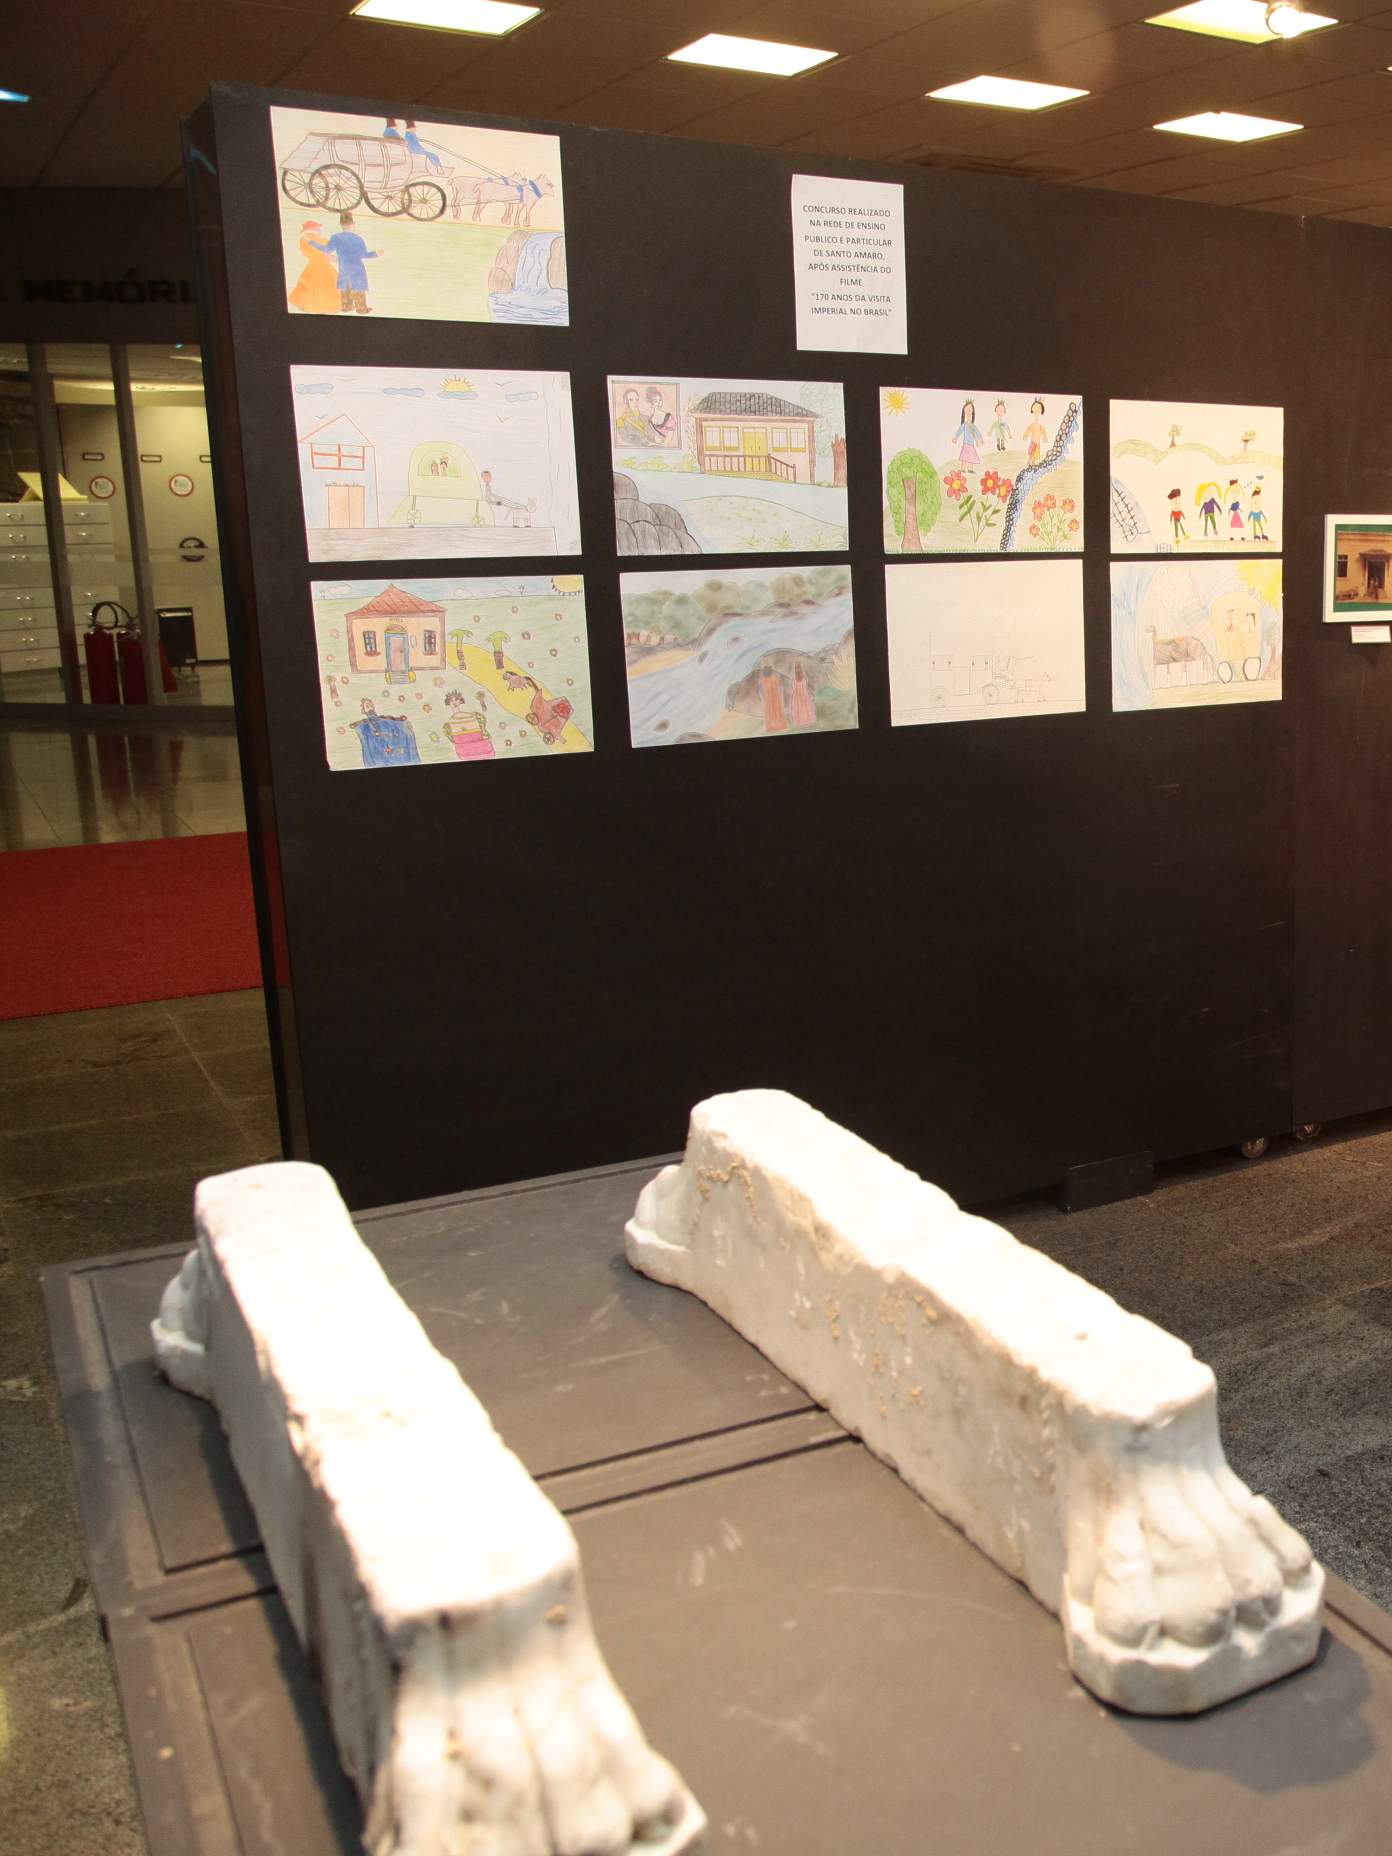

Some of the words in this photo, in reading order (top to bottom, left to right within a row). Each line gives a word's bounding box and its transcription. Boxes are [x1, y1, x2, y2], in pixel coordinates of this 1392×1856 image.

[803, 205, 846, 215] CONCURSO
[848, 208, 891, 217] REALIZADO
[810, 219, 821, 227] NA
[824, 220, 843, 228] REDE
[845, 221, 855, 229] DE
[857, 222, 886, 230] ENSINO
[804, 235, 838, 243] PUBLICO
[840, 236, 845, 244] E
[846, 237, 892, 246] PARTICULAR
[813, 249, 824, 257] DE
[825, 250, 852, 258] SANTO
[854, 251, 885, 261] AMARO,
[808, 262, 829, 271] APÓS
[831, 263, 879, 273] ASSISTÊNCIA
[880, 266, 891, 274] DO
[22, 267, 197, 303] MEMÓRI
[839, 278, 863, 286] FILME
[831, 293, 853, 302] ANOS
[855, 294, 867, 302] DA
[867, 295, 892, 303] VISITA
[811, 306, 848, 315] IMPERIAL
[850, 308, 862, 316] NO
